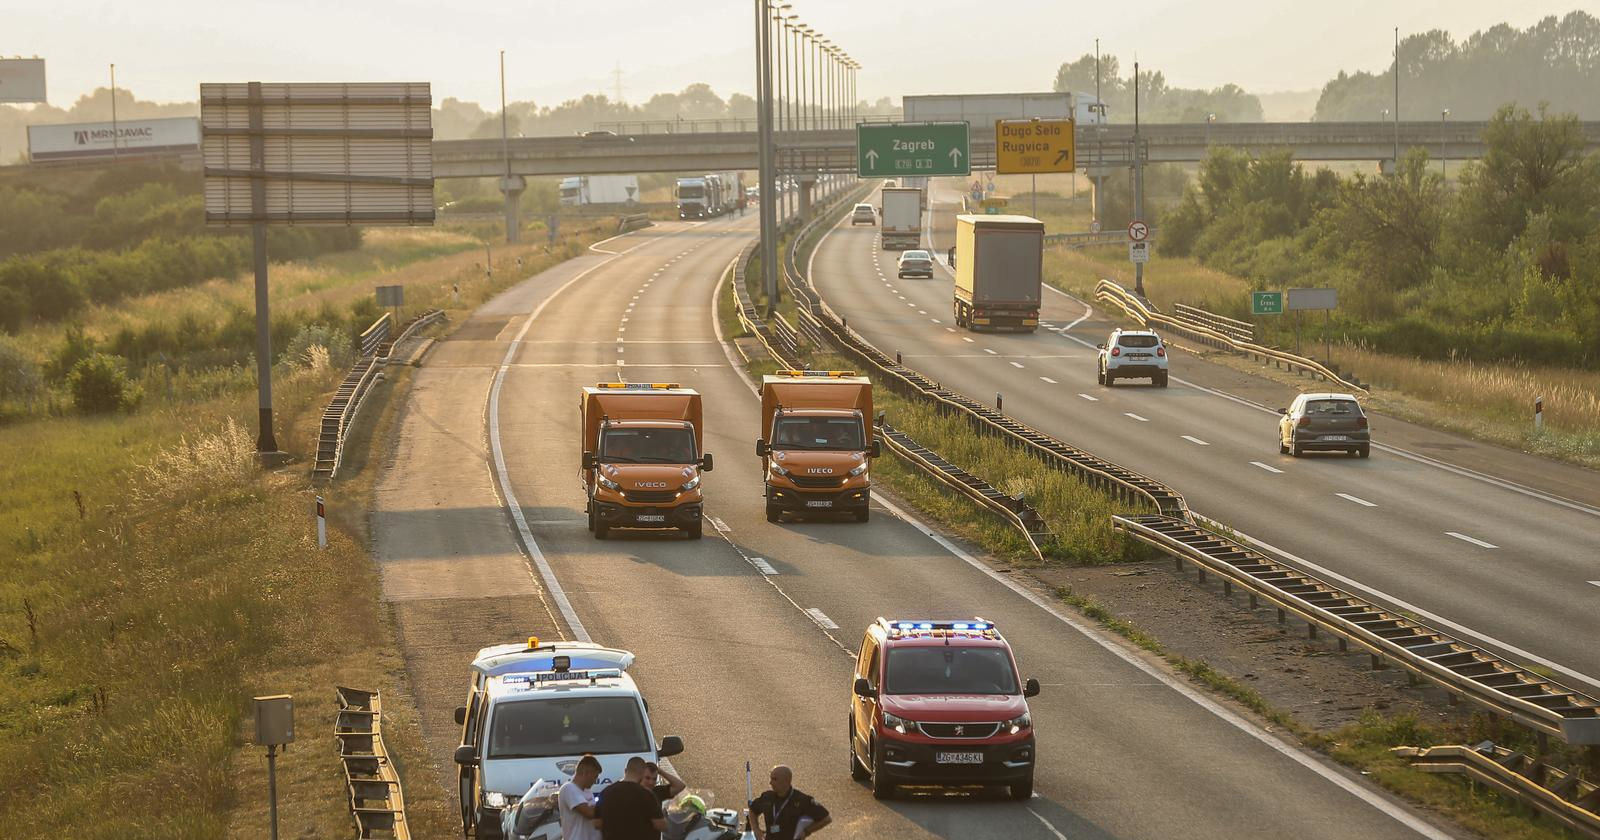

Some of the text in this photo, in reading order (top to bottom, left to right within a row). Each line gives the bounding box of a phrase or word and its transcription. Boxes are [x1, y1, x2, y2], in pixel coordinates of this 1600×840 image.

[1002, 124, 1060, 138] Dugo Selo
[893, 139, 935, 153] Zagreb
[1002, 141, 1050, 154] Rugvica
[541, 672, 585, 681] POLICIJA
